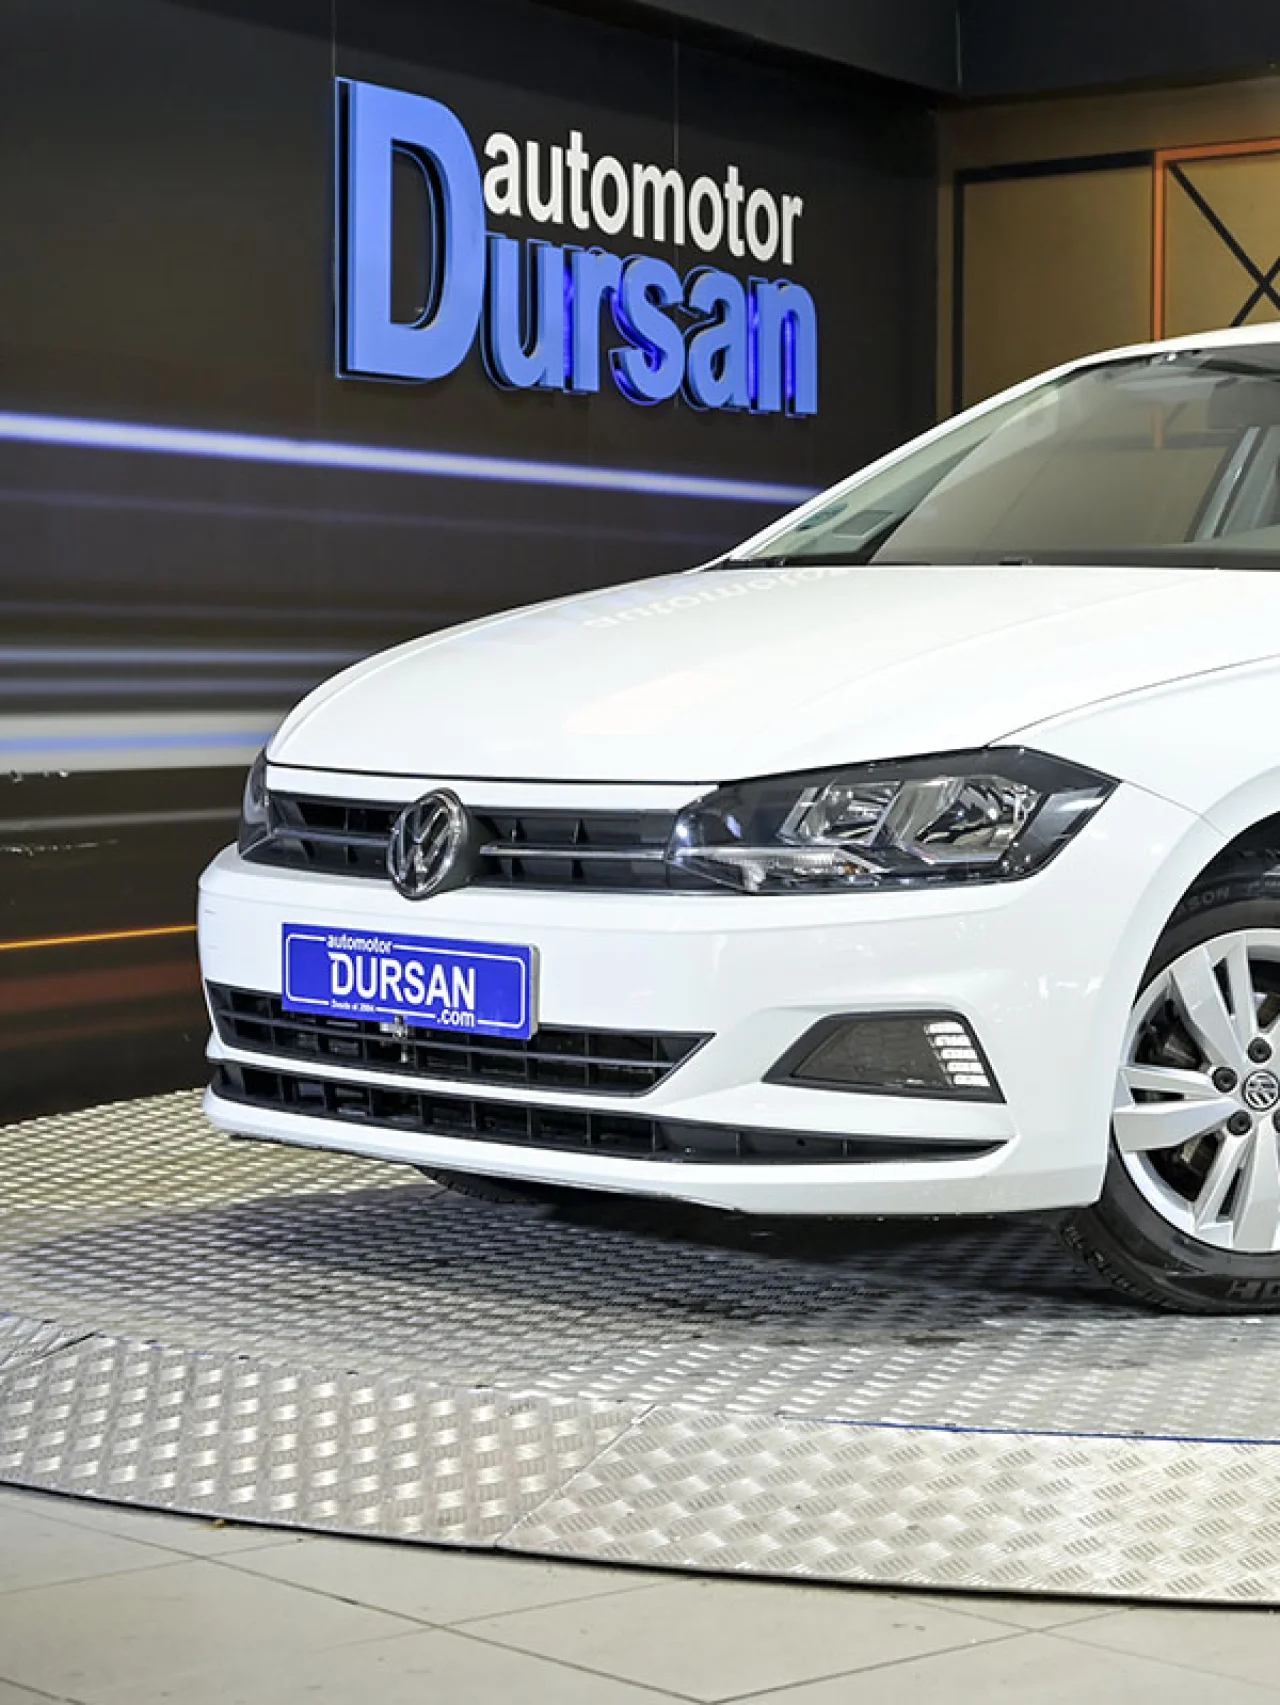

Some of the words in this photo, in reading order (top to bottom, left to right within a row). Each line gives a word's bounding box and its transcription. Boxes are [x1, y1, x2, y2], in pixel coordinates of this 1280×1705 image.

[484, 130, 803, 265] automotor
[335, 76, 818, 417] Dursan
[326, 932, 393, 954] automotor
[327, 951, 476, 1010] DURSAN
[436, 1009, 475, 1028] .com
